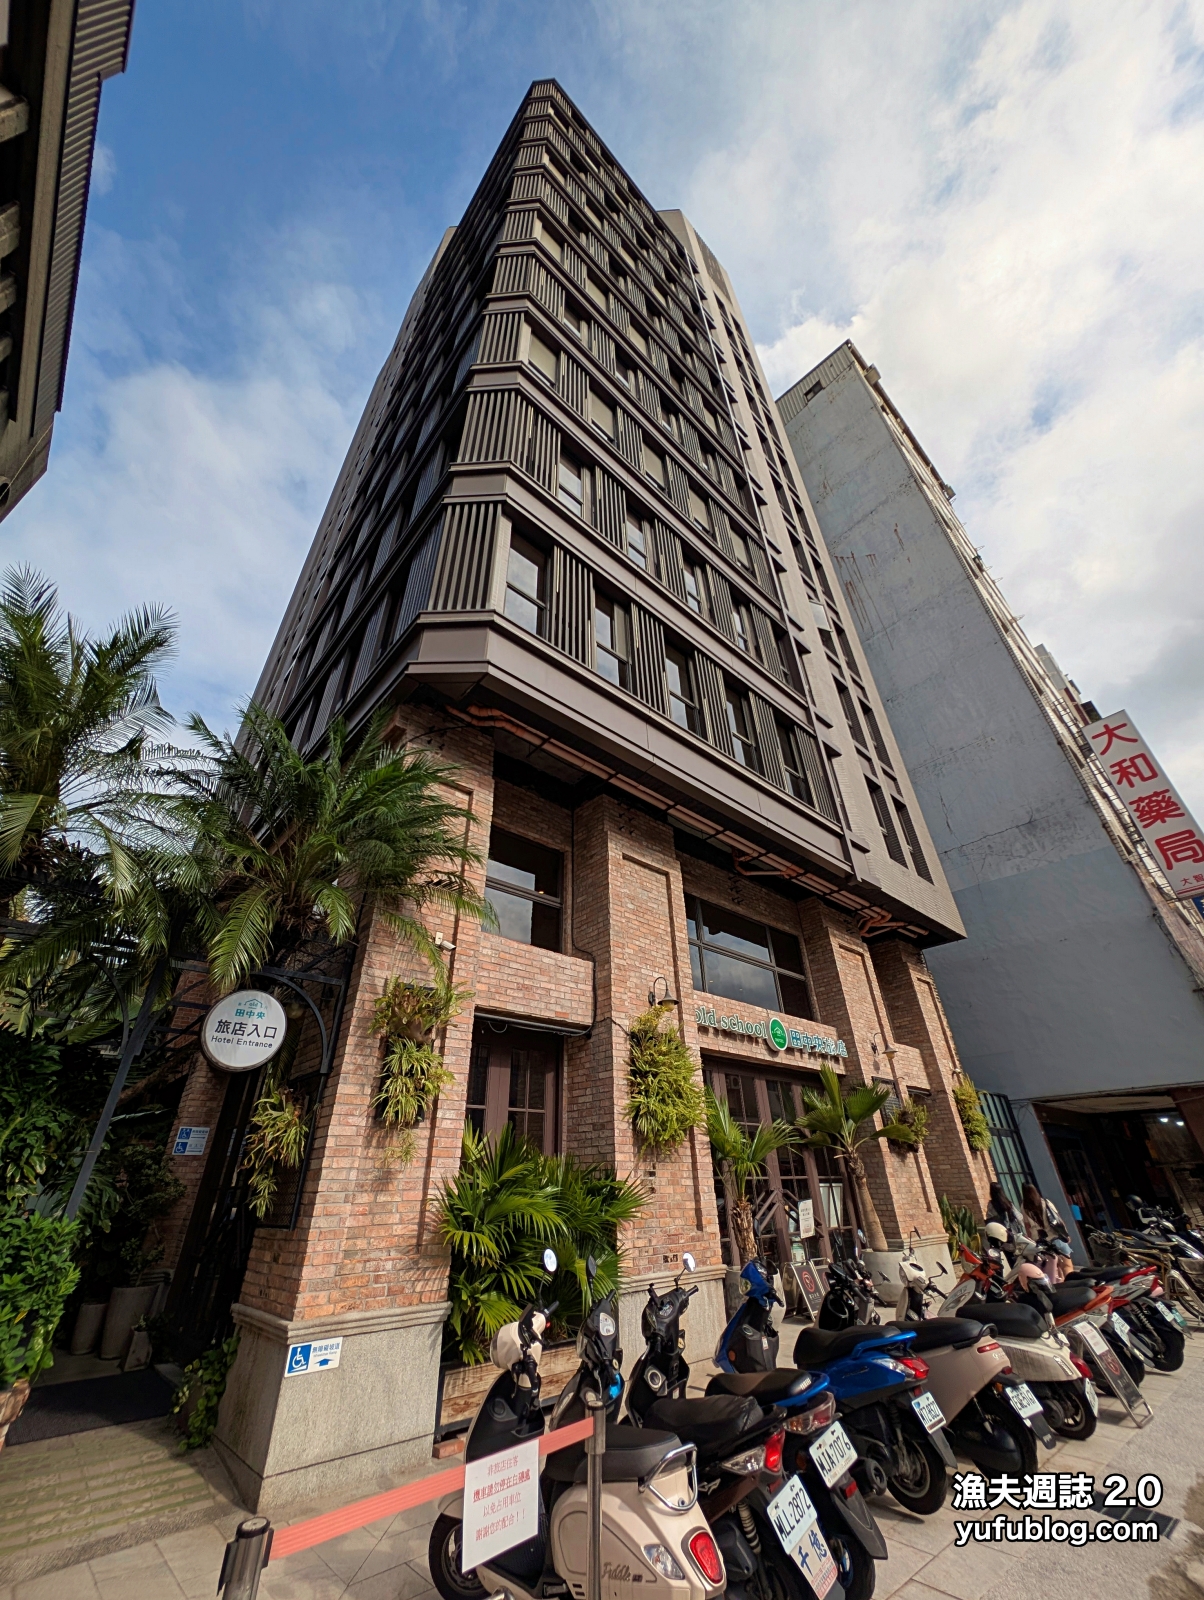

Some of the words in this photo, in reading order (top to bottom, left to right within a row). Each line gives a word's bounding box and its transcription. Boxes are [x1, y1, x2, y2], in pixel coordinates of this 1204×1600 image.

[1091, 722, 1204, 871] 大和藥局
[235, 1008, 266, 1020] 田中央
[214, 1018, 278, 1039] 旅店入口
[720, 1014, 768, 1039] school
[211, 1035, 234, 1045] Hotel
[236, 1038, 273, 1049] Entrance
[789, 1028, 849, 1058] 田中央旅店
[487, 1455, 519, 1477] 非旅店住客
[473, 1468, 531, 1503] 機車請勿停在白磚處
[601, 1561, 631, 1582] Fiddle
